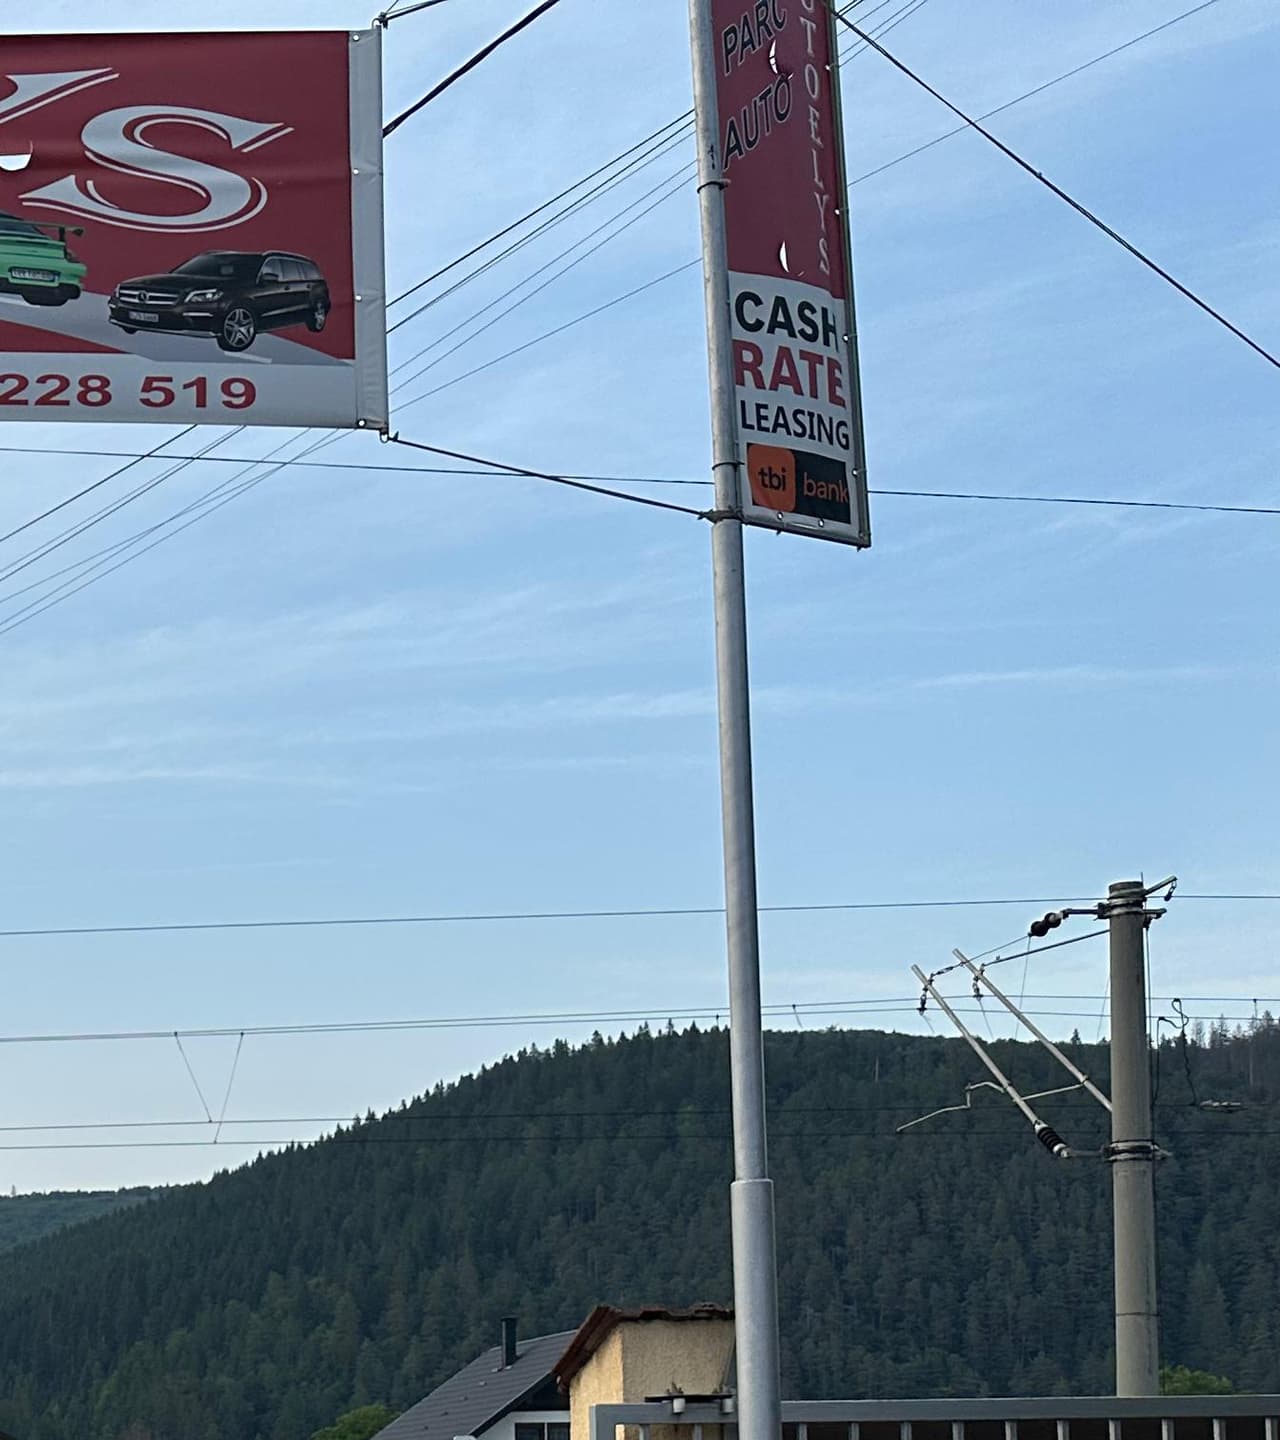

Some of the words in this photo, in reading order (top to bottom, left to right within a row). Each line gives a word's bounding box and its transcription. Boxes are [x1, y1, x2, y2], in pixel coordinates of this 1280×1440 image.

[723, 73, 793, 172] AUTO
[735, 291, 839, 353] CASH
[140, 376, 258, 410] 519
[732, 338, 847, 409] RATE
[740, 399, 850, 451] LEASING
[758, 465, 787, 492] tbi
[803, 471, 849, 504] bank
